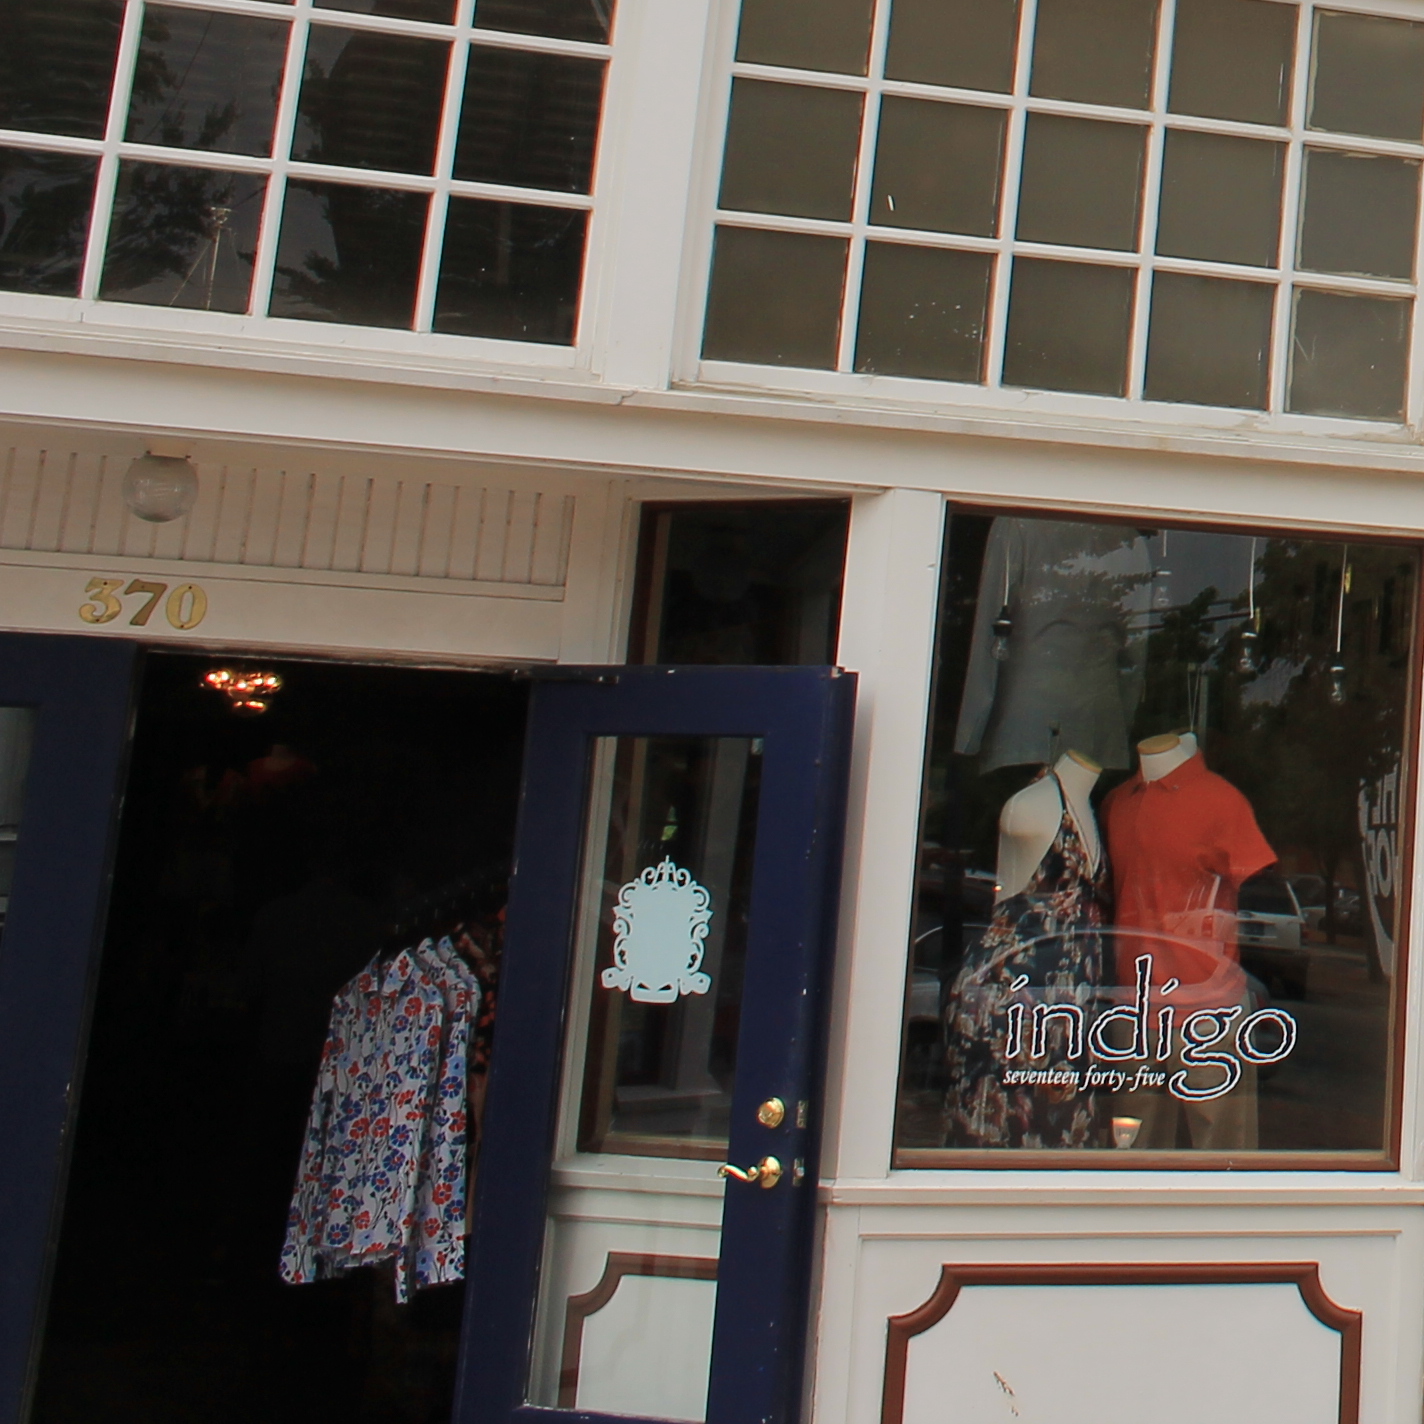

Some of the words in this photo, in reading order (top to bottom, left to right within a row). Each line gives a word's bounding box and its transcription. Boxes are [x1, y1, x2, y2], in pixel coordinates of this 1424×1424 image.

[79, 577, 207, 630] 370
[1005, 954, 1297, 1101] indigo
[1002, 1067, 1080, 1085] seventeen
[1079, 1064, 1166, 1092] forty-five
